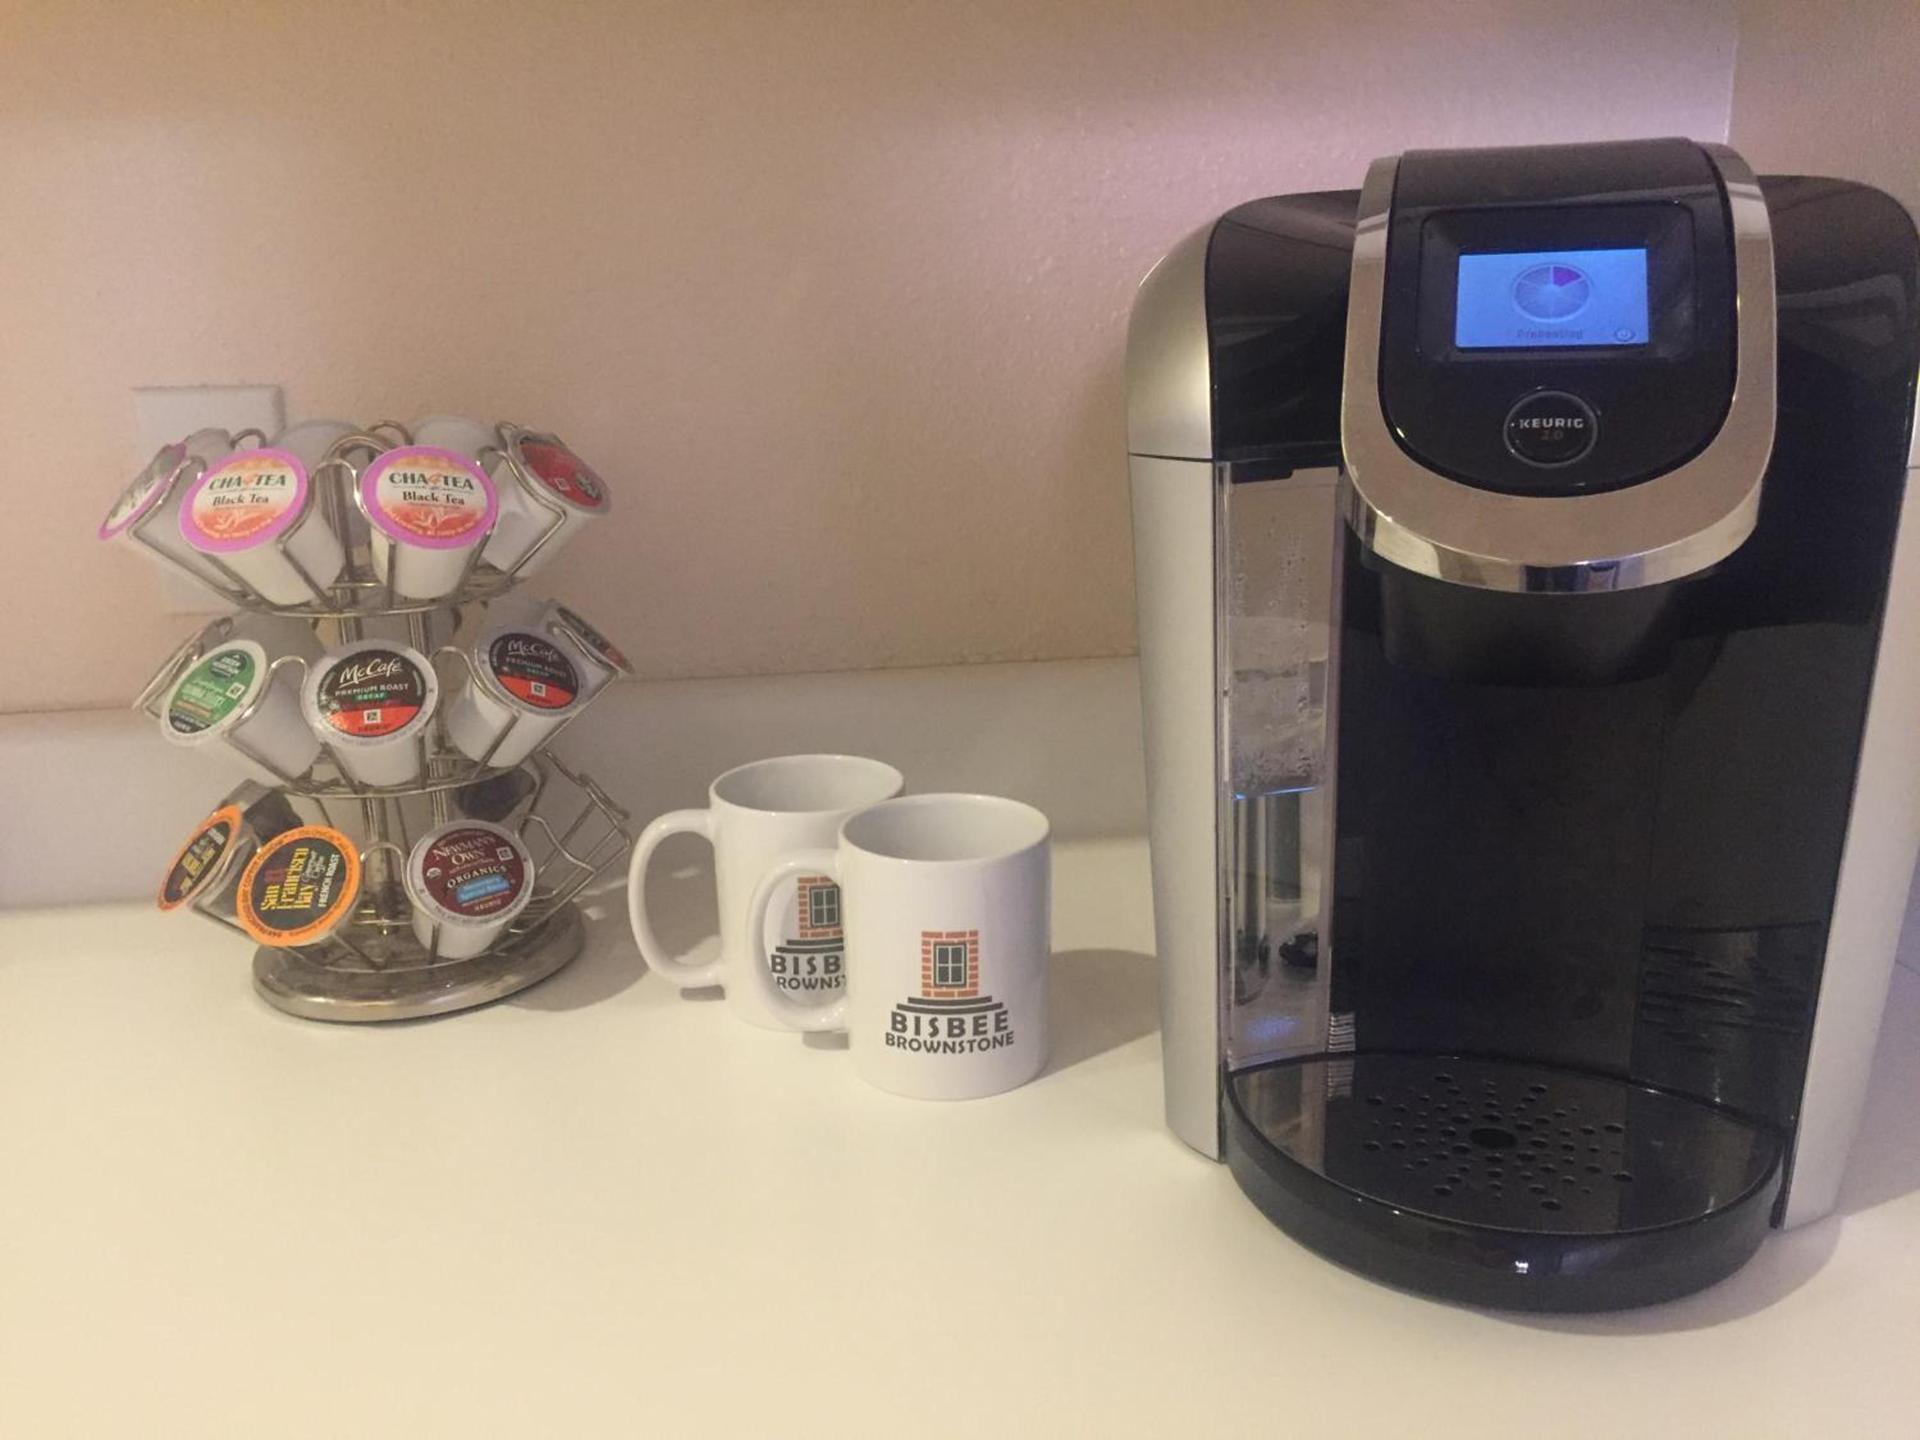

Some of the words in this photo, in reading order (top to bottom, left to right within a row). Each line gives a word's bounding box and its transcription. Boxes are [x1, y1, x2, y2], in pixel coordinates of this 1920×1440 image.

[1519, 417, 1584, 429] KEURIG
[212, 494, 245, 506] Black
[249, 493, 269, 503] Tea
[402, 490, 438, 502] Black
[445, 494, 465, 505] Tea
[335, 685, 377, 697] PREMIUM
[379, 683, 409, 693] ROAST
[276, 847, 310, 909] Francisco
[317, 877, 333, 908] FRENCH
[325, 853, 340, 876] ROAST
[260, 885, 280, 911] San
[770, 953, 842, 976] BISB
[776, 974, 846, 990] ROWNS
[891, 1009, 1009, 1039] BISBEE
[885, 1030, 1015, 1054] BROWNSTONE
